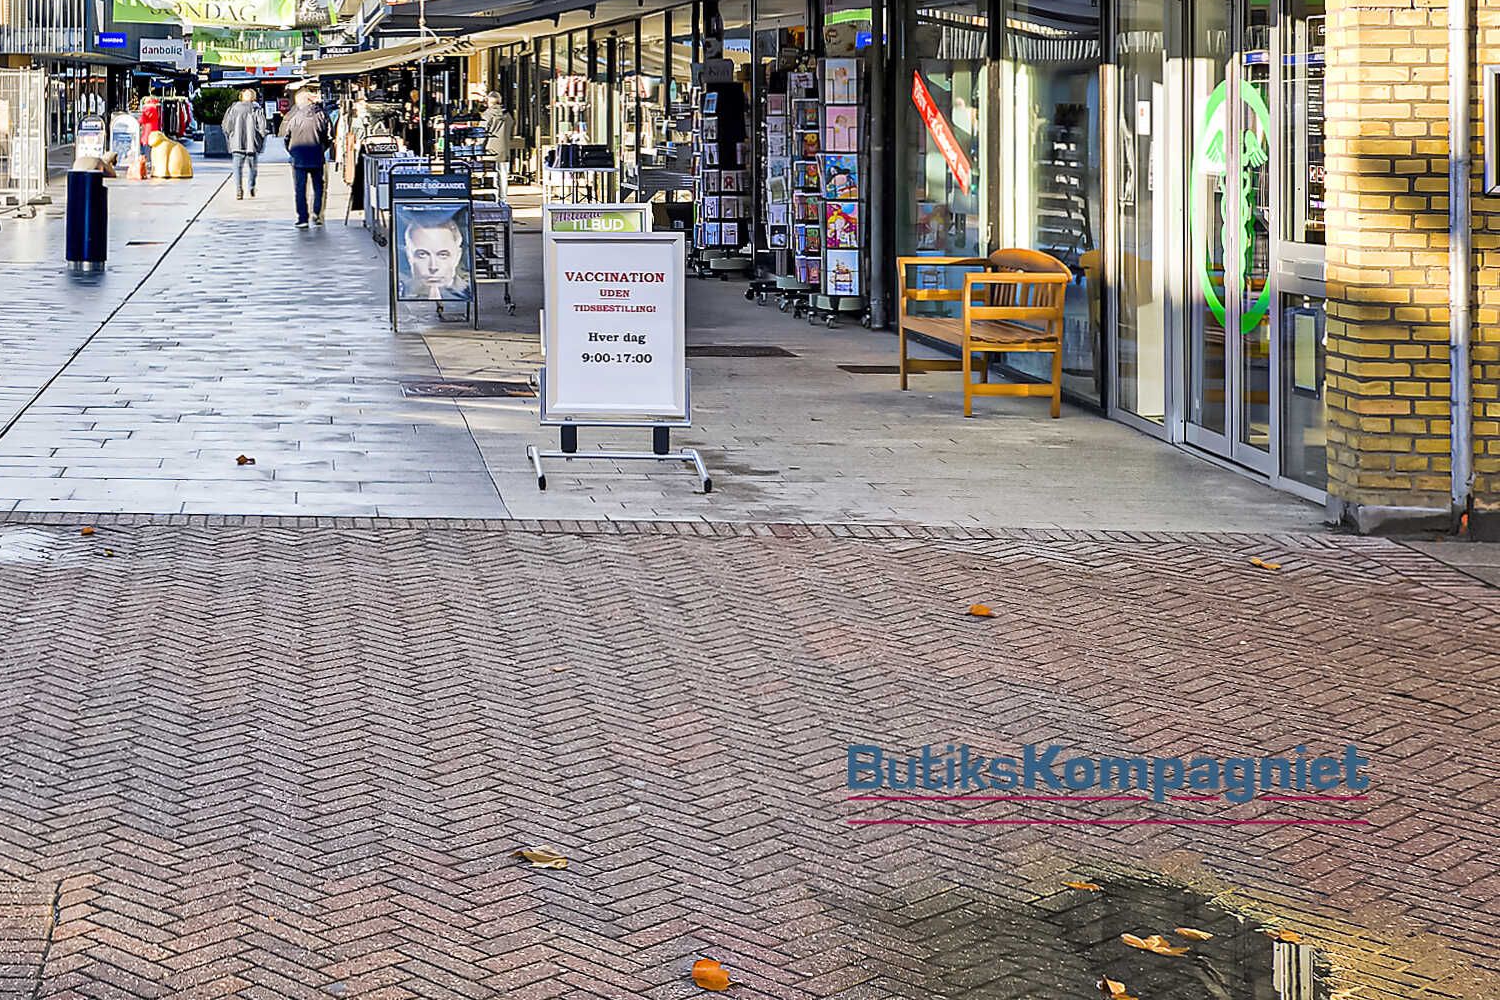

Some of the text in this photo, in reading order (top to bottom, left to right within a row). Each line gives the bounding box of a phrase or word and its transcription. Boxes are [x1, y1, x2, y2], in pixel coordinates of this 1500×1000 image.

[572, 219, 625, 232] TILBUD
[564, 271, 665, 283] VACCINATION
[599, 289, 630, 298] UDEN
[573, 304, 657, 313] TIDSBESTILLING!
[588, 332, 647, 345] Hver dag
[581, 353, 653, 364] 9:00-17:00
